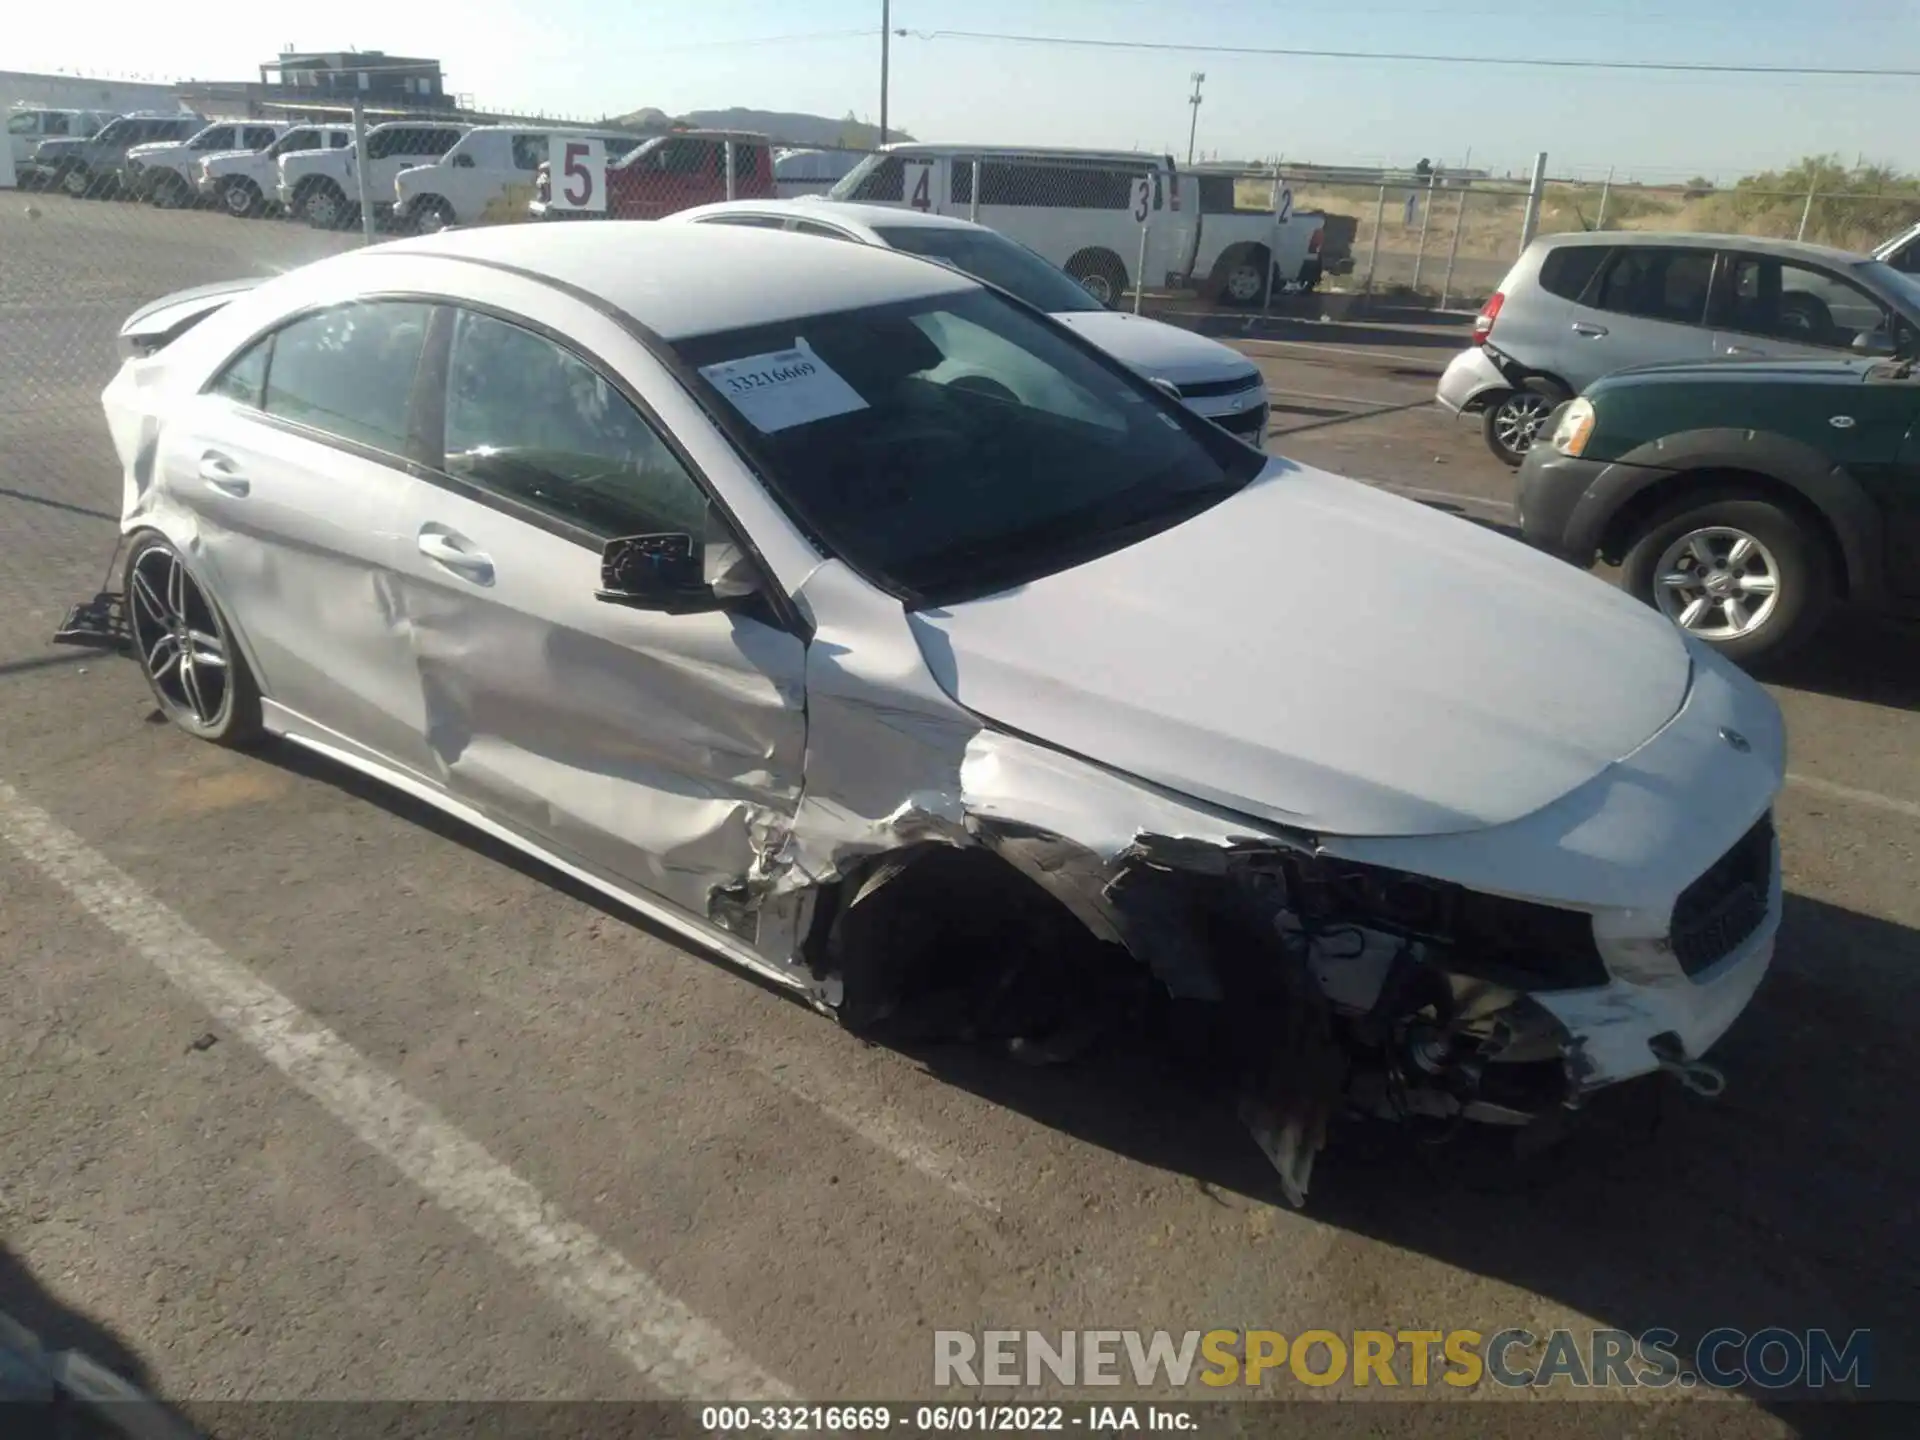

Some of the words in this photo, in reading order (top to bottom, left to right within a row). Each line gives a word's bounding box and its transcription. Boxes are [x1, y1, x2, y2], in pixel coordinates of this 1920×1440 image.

[564, 142, 593, 207] 5
[911, 167, 932, 213] 4
[1135, 181, 1150, 223] 3
[1278, 189, 1291, 225] 2
[1407, 195, 1416, 225] 1
[726, 362, 816, 393] 33216669
